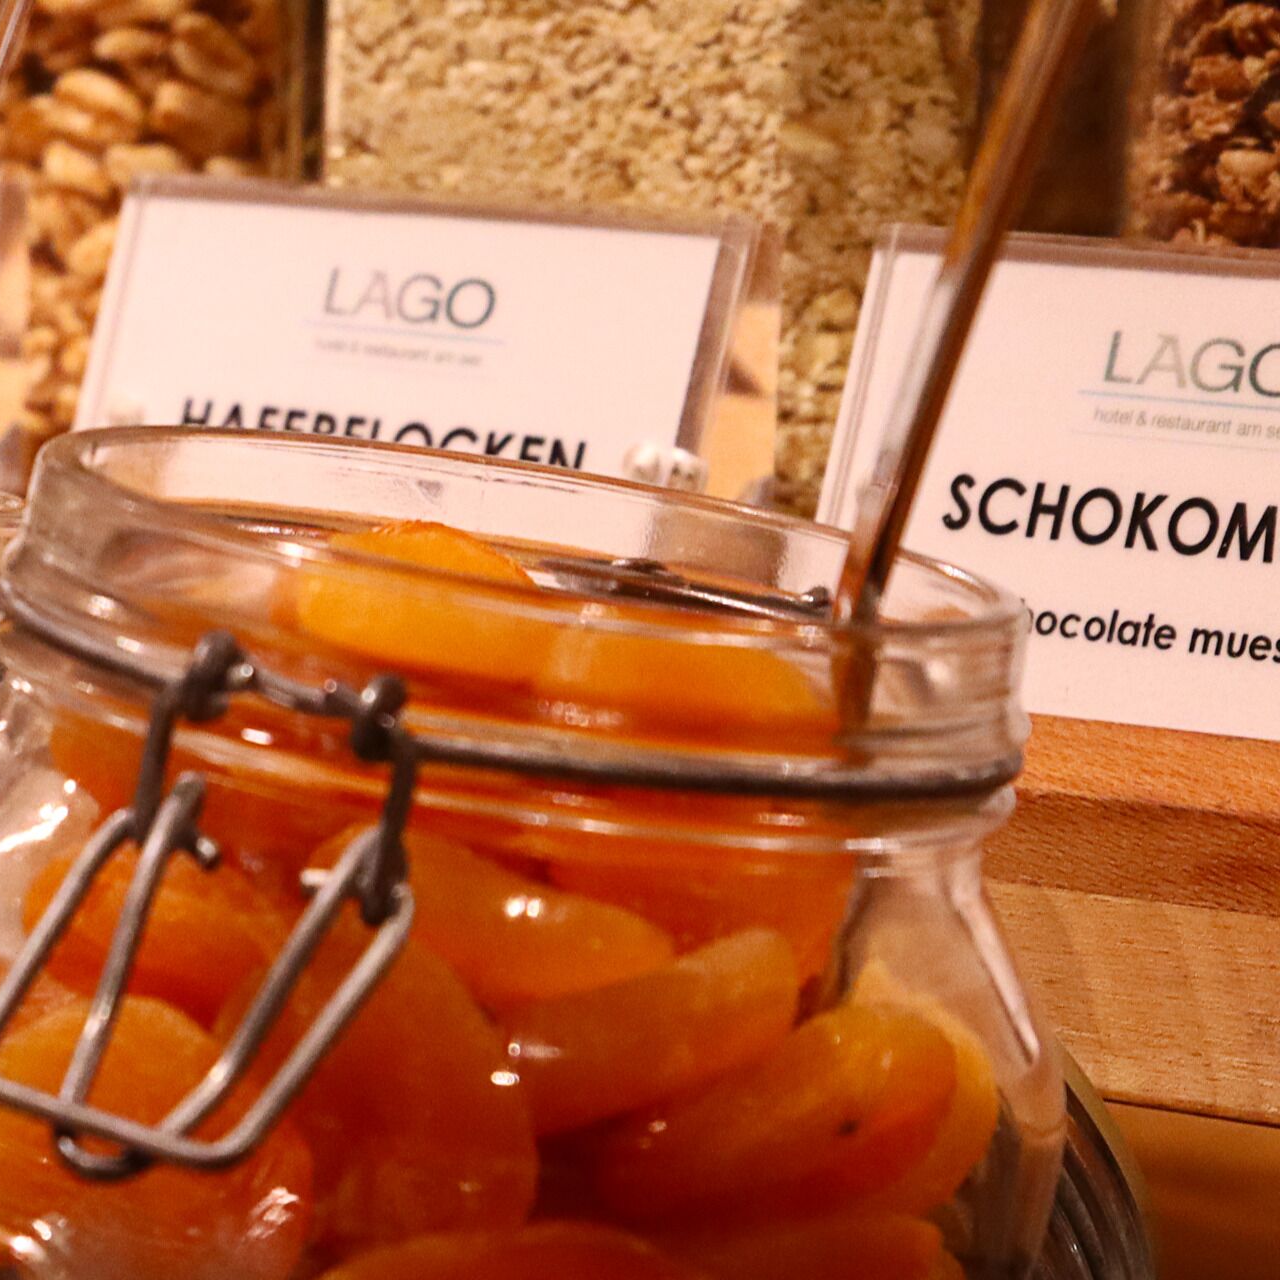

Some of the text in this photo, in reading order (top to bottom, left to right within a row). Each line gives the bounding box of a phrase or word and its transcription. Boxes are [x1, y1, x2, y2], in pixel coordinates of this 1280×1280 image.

[323, 267, 497, 330] LAGO
[1103, 330, 1280, 400] LAGO
[1093, 404, 1134, 426] hotel
[1135, 410, 1148, 427] &
[1151, 412, 1233, 435] restaurant
[1236, 422, 1262, 438] am
